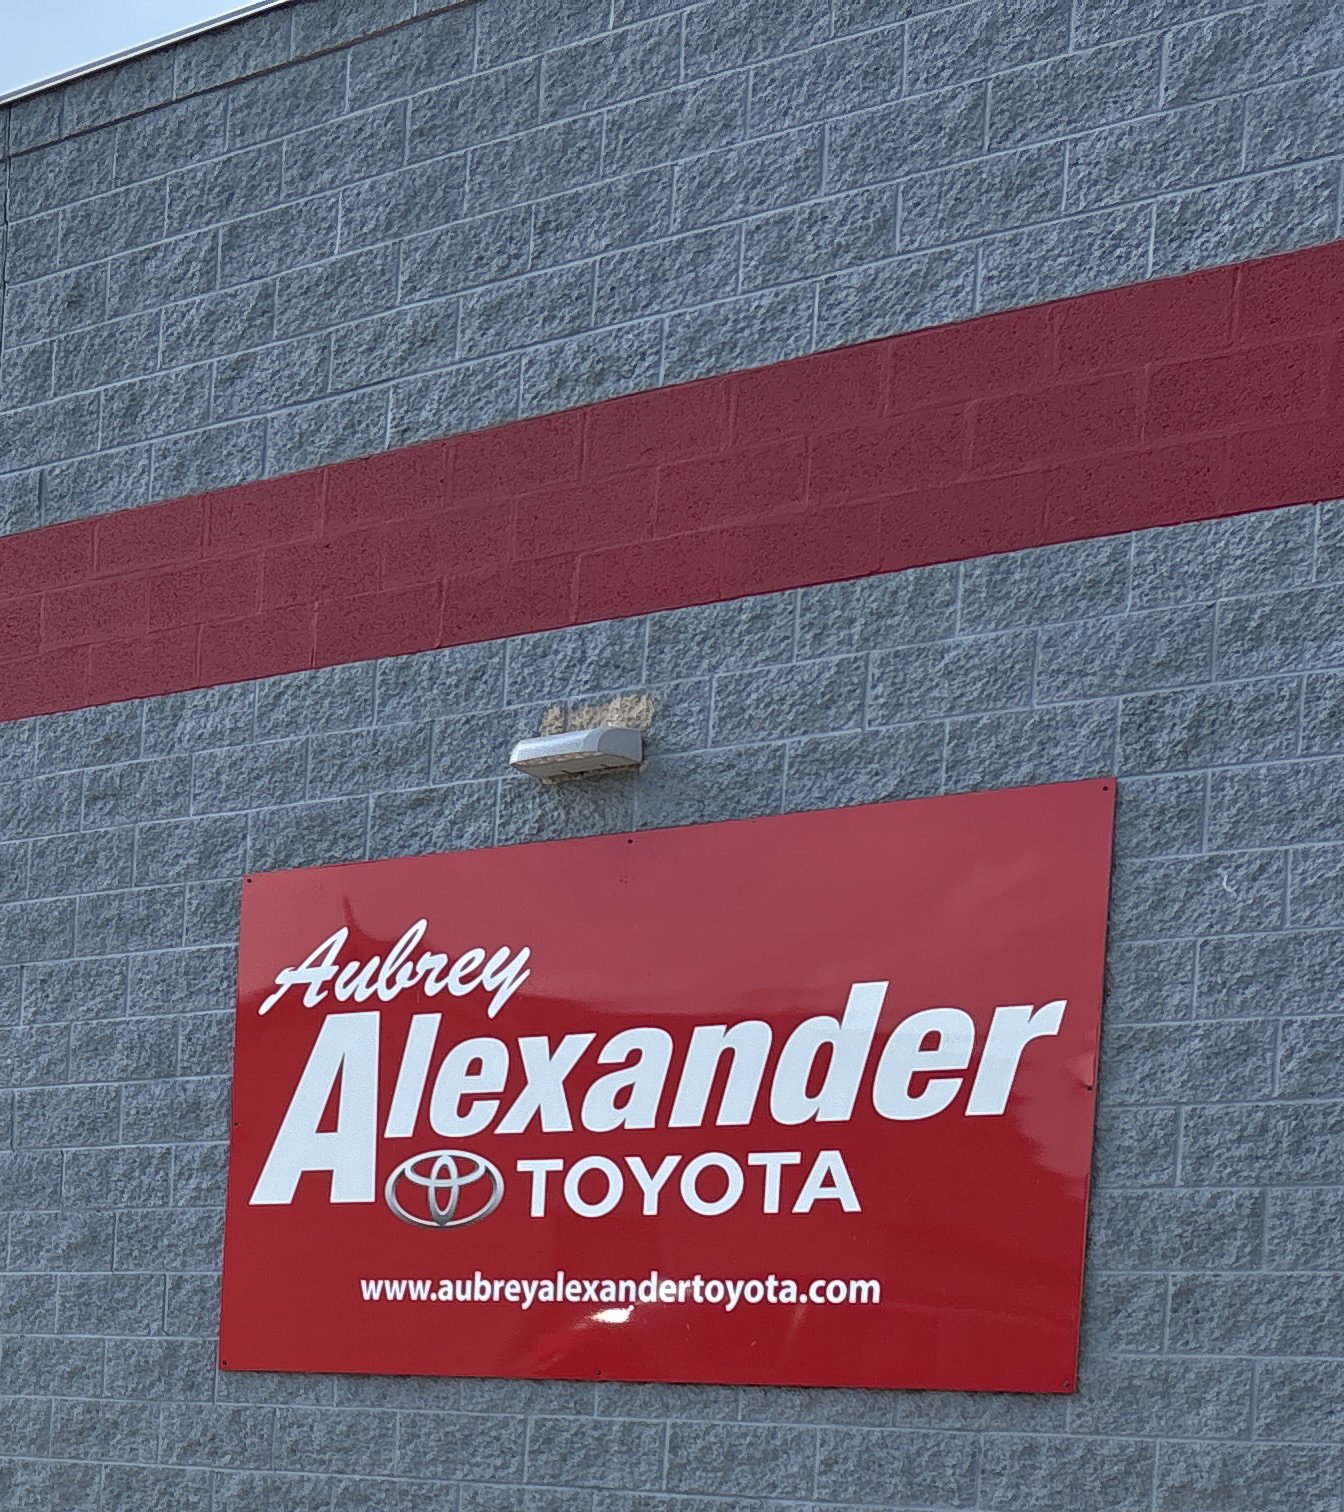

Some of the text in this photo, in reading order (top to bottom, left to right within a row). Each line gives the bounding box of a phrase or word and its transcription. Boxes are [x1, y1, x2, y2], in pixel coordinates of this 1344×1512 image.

[258, 917, 531, 1019] Aubrey
[249, 980, 1068, 1206] Alexander
[516, 1149, 862, 1218] TOYOTA
[360, 1270, 881, 1312] www.aubreyalexandertoyota.com
